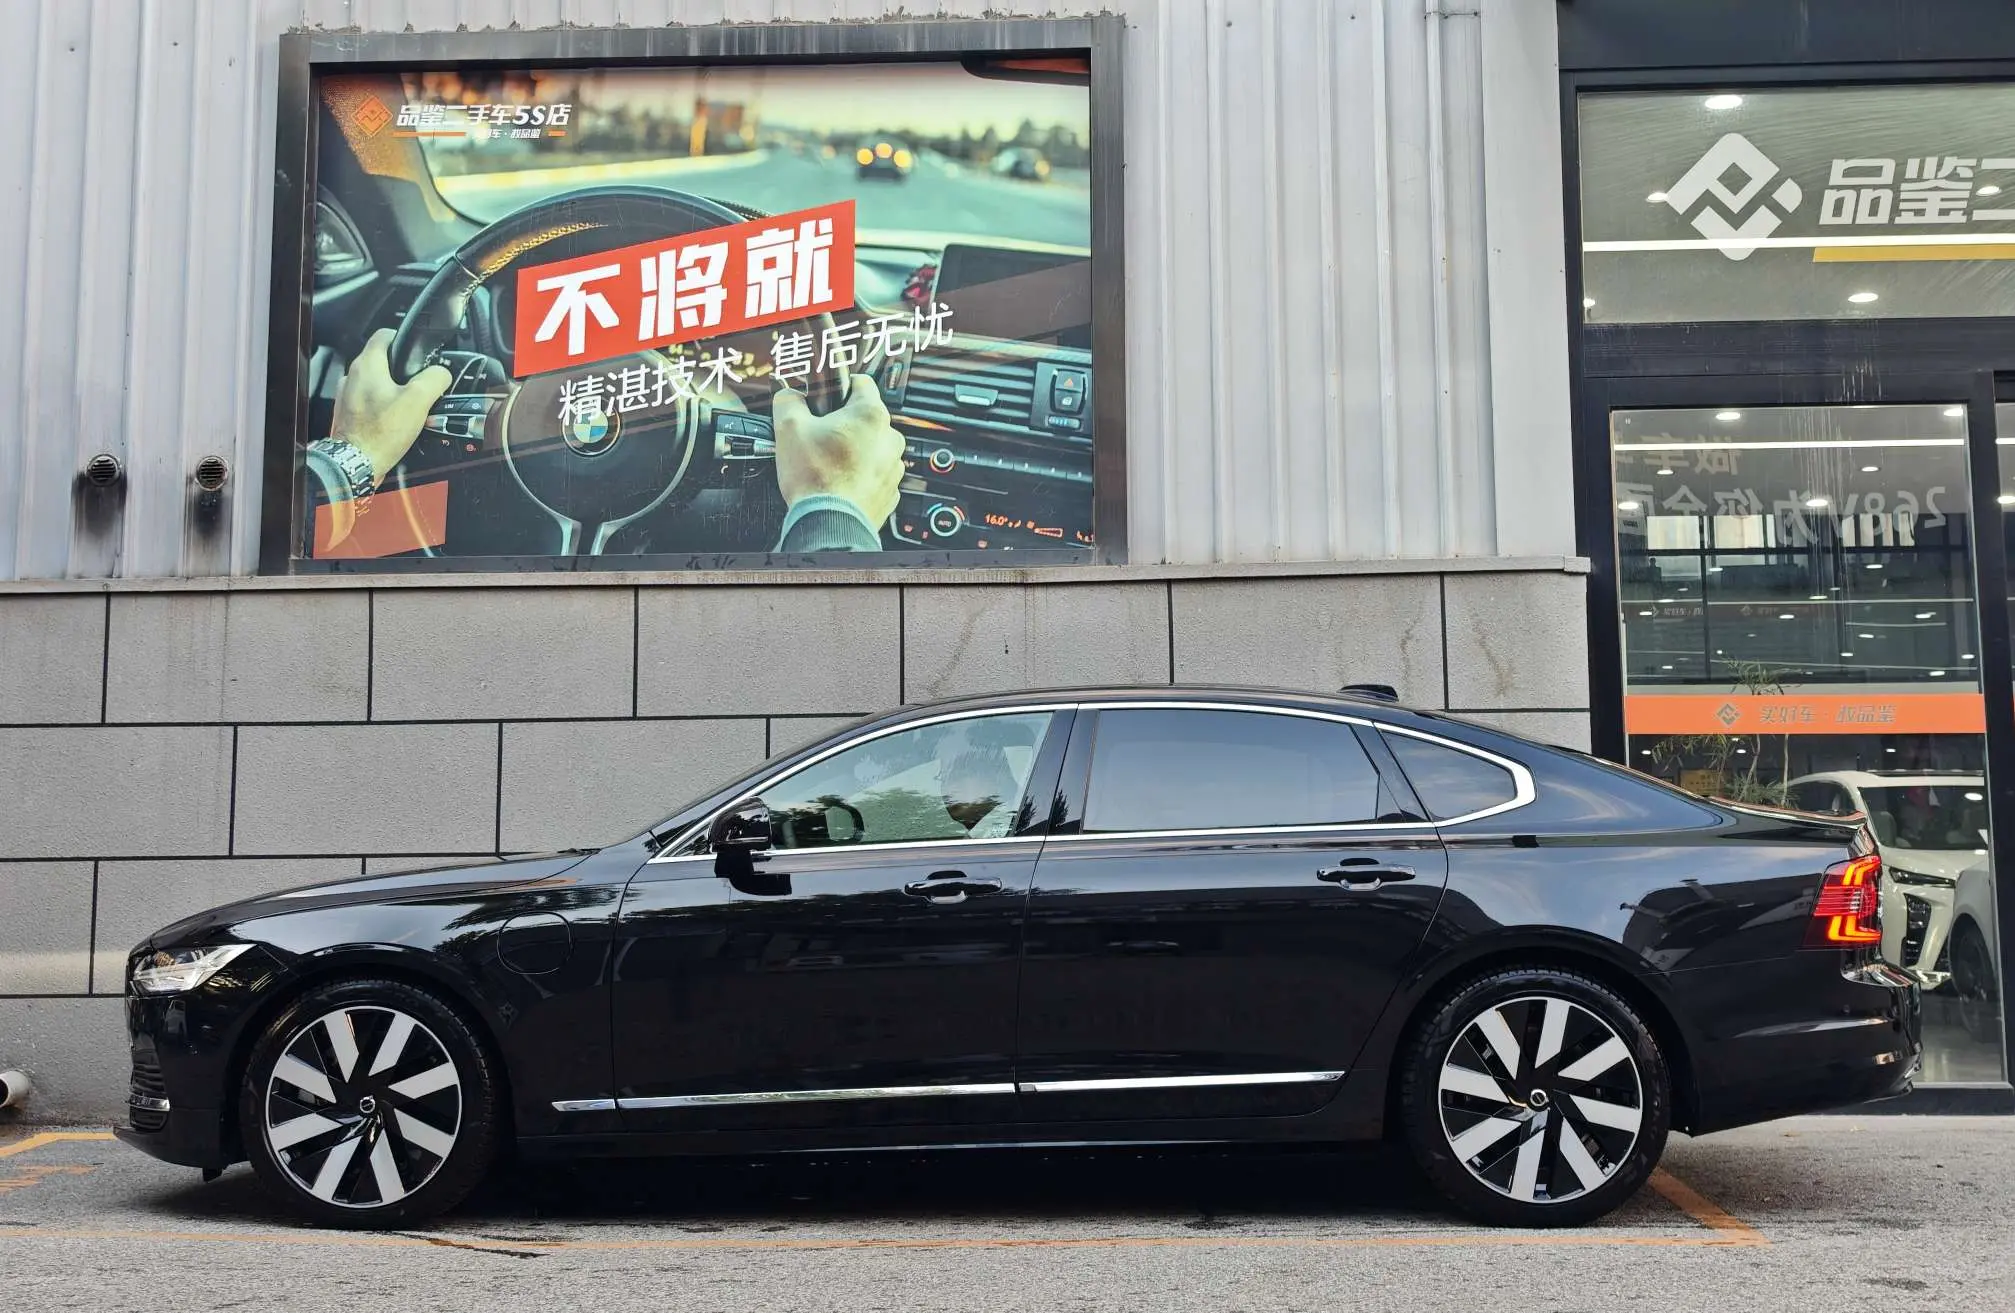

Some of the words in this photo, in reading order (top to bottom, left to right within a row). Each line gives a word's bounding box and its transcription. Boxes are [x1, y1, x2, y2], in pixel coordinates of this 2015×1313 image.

[396, 103, 573, 127] 品鉴二手车5S店
[534, 217, 834, 357] 不将就
[557, 346, 743, 426] 精湛技术
[768, 302, 955, 381] 售后无忧
